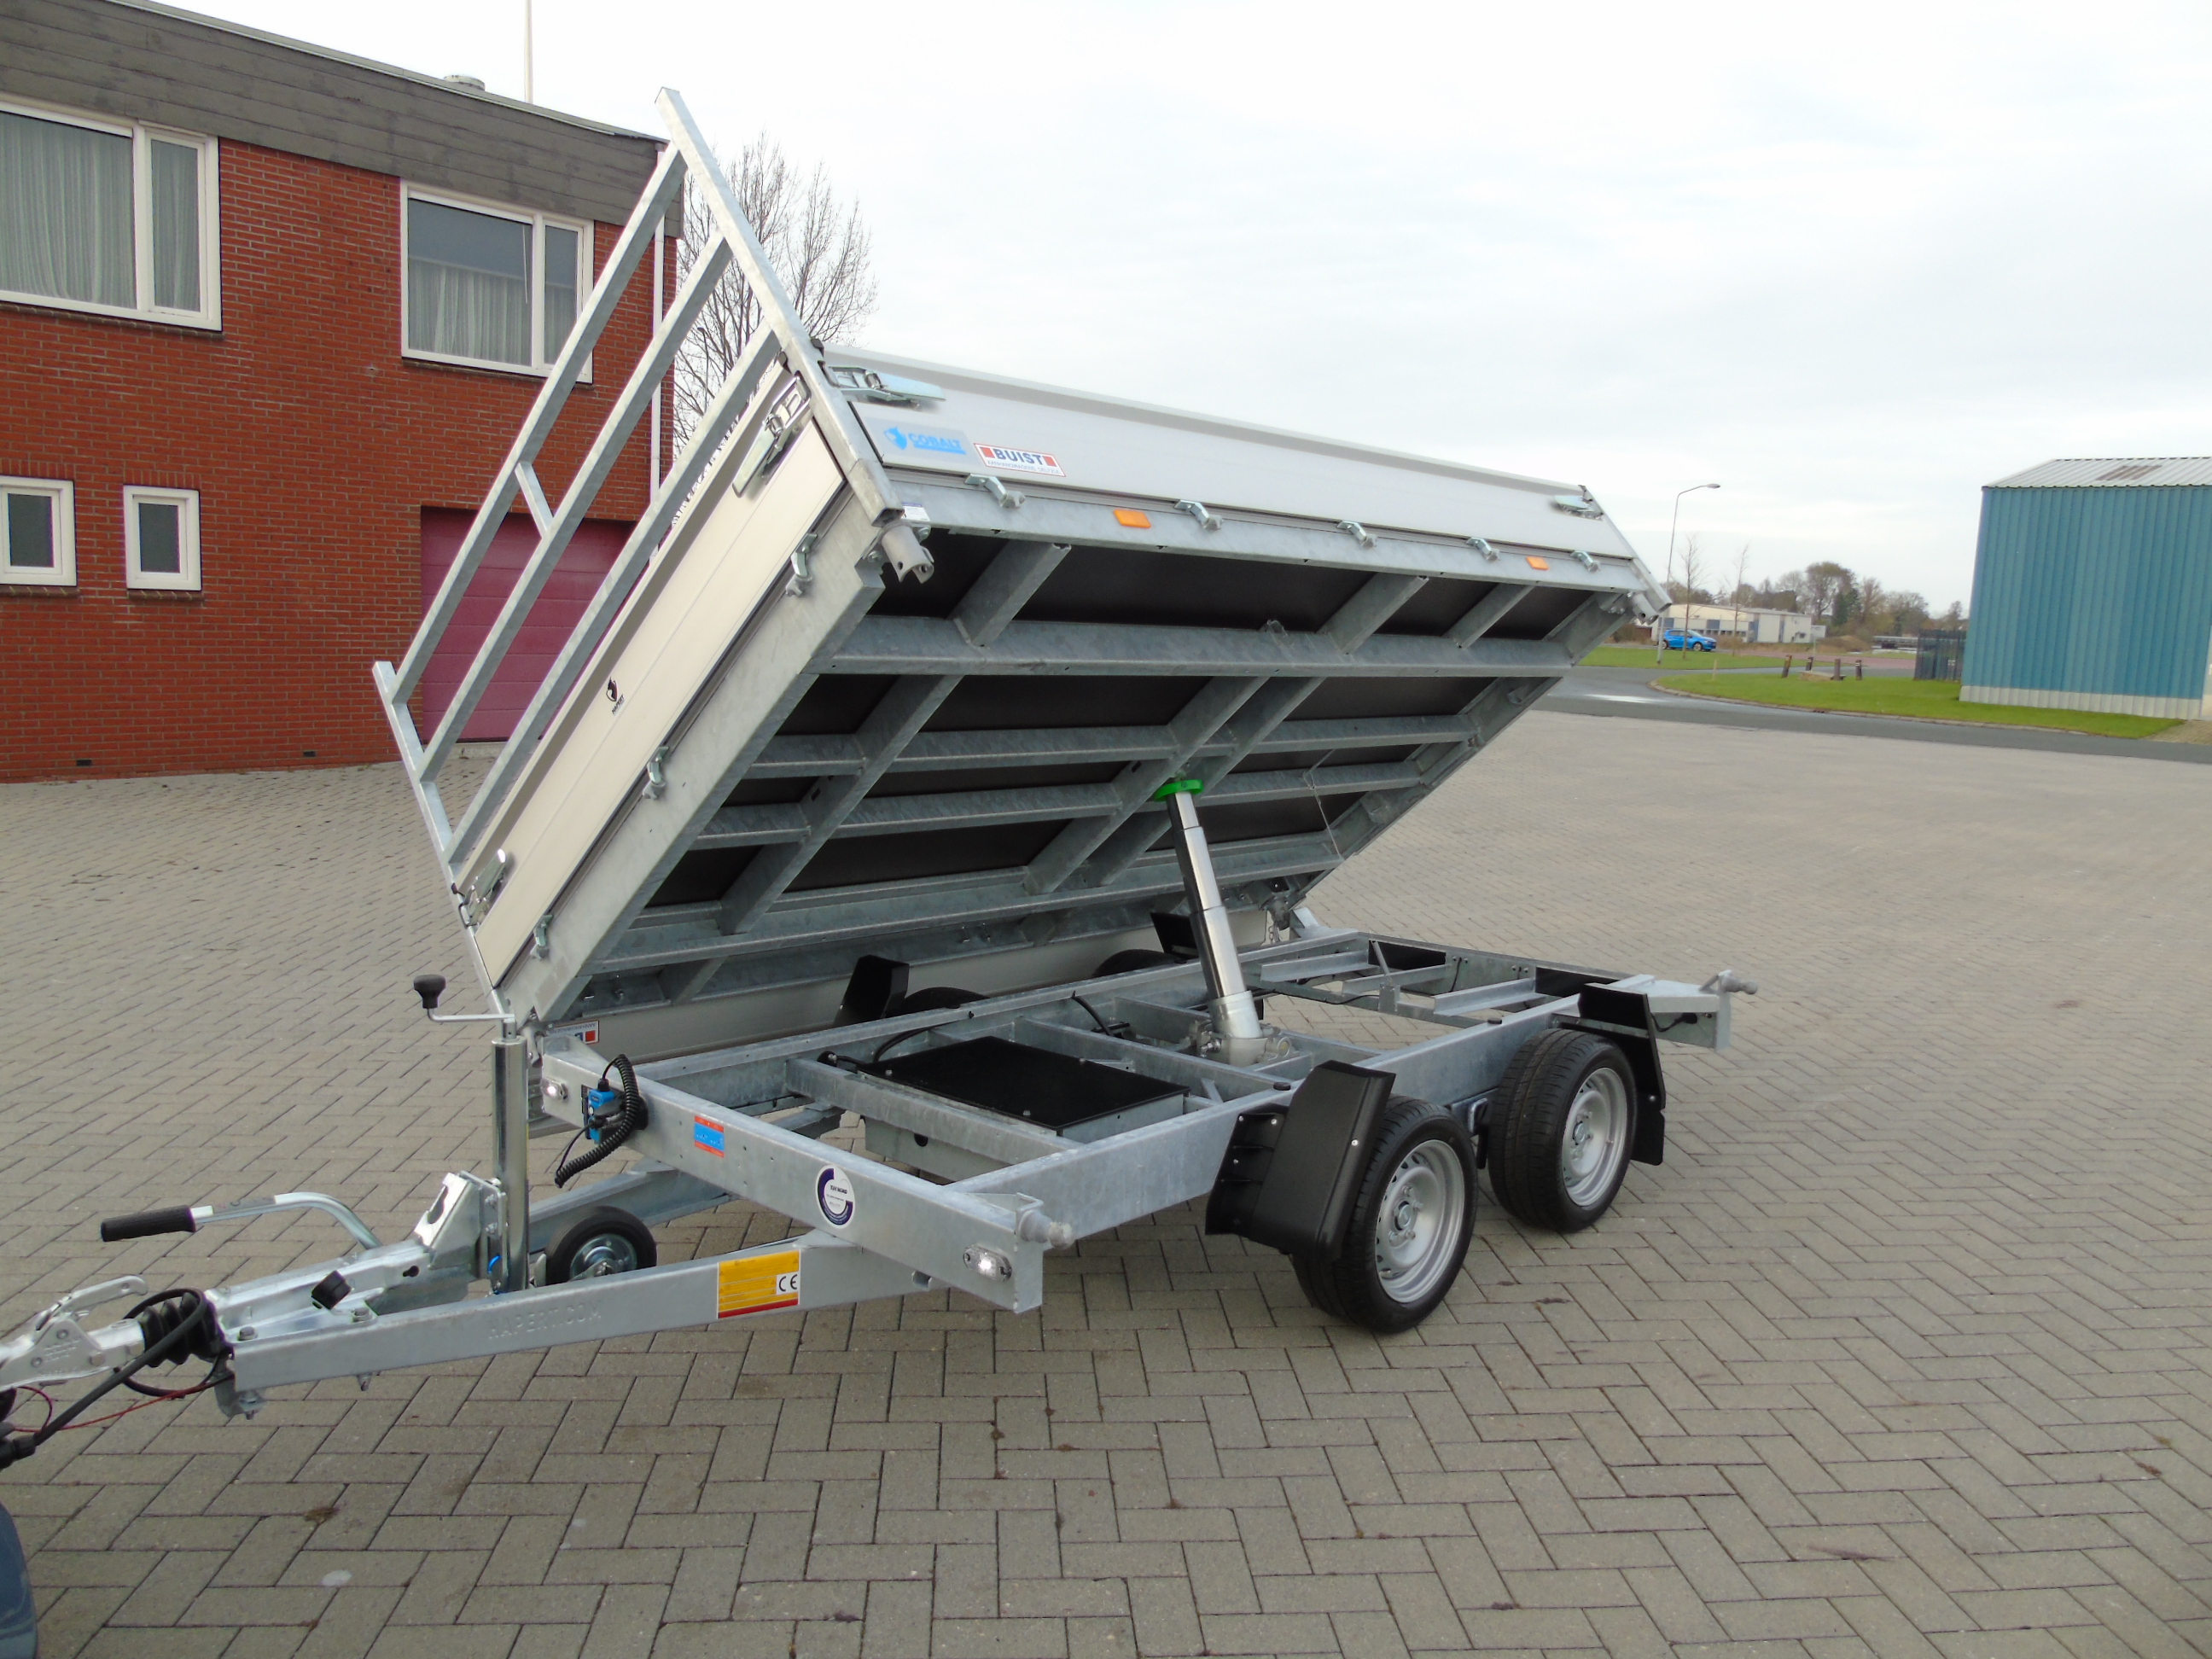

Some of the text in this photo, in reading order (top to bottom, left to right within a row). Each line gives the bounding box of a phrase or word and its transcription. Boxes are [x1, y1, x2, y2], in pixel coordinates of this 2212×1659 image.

[908, 433, 962, 450] COBALT
[992, 448, 1044, 466] BUIST
[778, 1273, 798, 1293] CE
